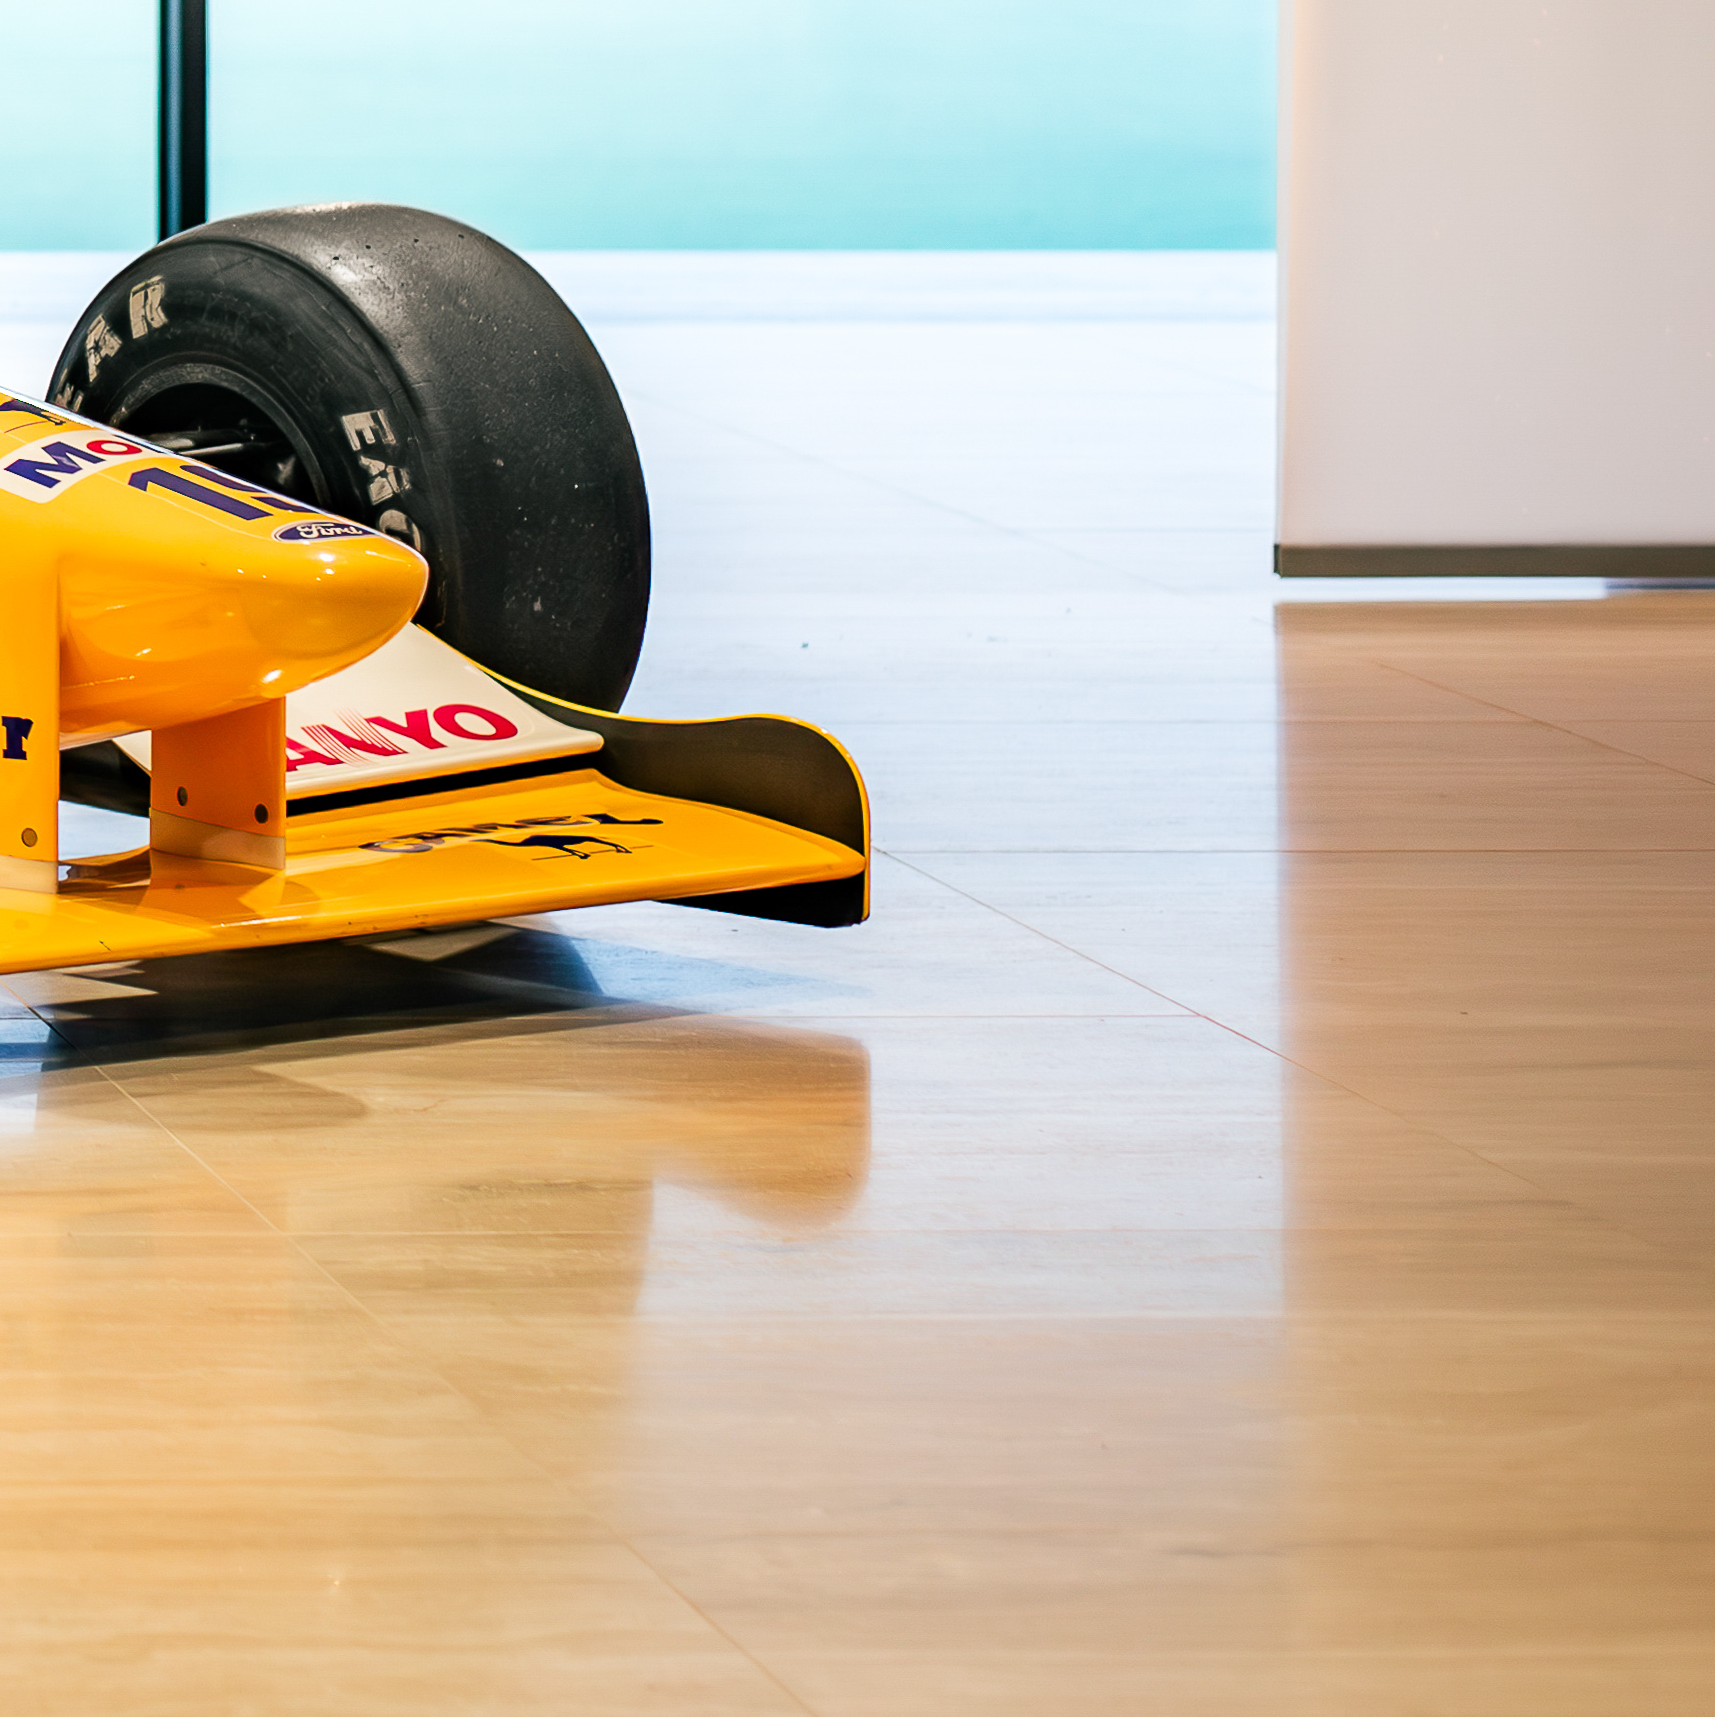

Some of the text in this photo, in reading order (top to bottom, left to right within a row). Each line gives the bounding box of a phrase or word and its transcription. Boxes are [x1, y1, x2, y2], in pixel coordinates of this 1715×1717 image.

[4, 434, 172, 489] Mo
[298, 521, 363, 539] Ford
[286, 704, 519, 773] ANYO
